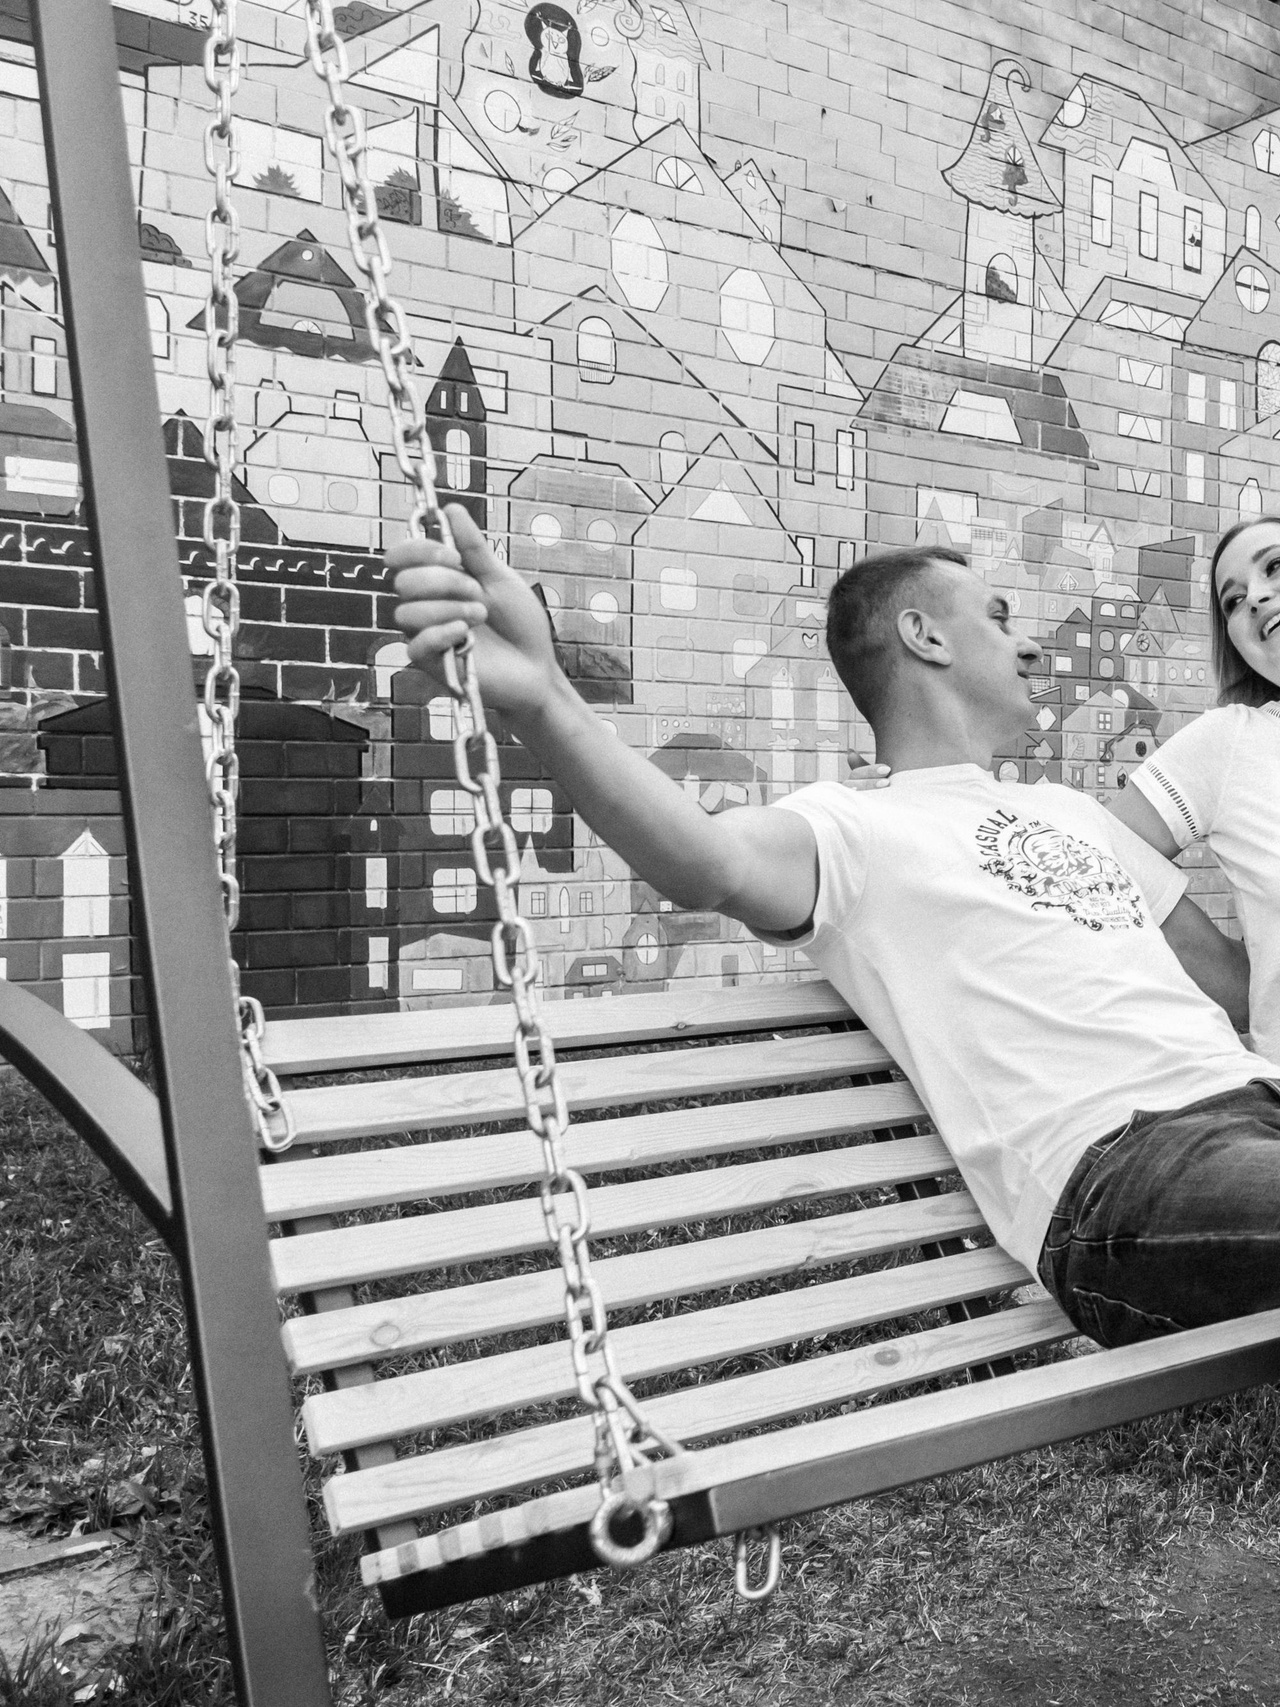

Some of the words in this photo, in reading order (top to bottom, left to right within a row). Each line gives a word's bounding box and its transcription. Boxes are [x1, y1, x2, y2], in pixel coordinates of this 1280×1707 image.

[188, 10, 209, 28] 35
[975, 809, 1018, 857] CASUAL
[1028, 820, 1041, 829] TM
